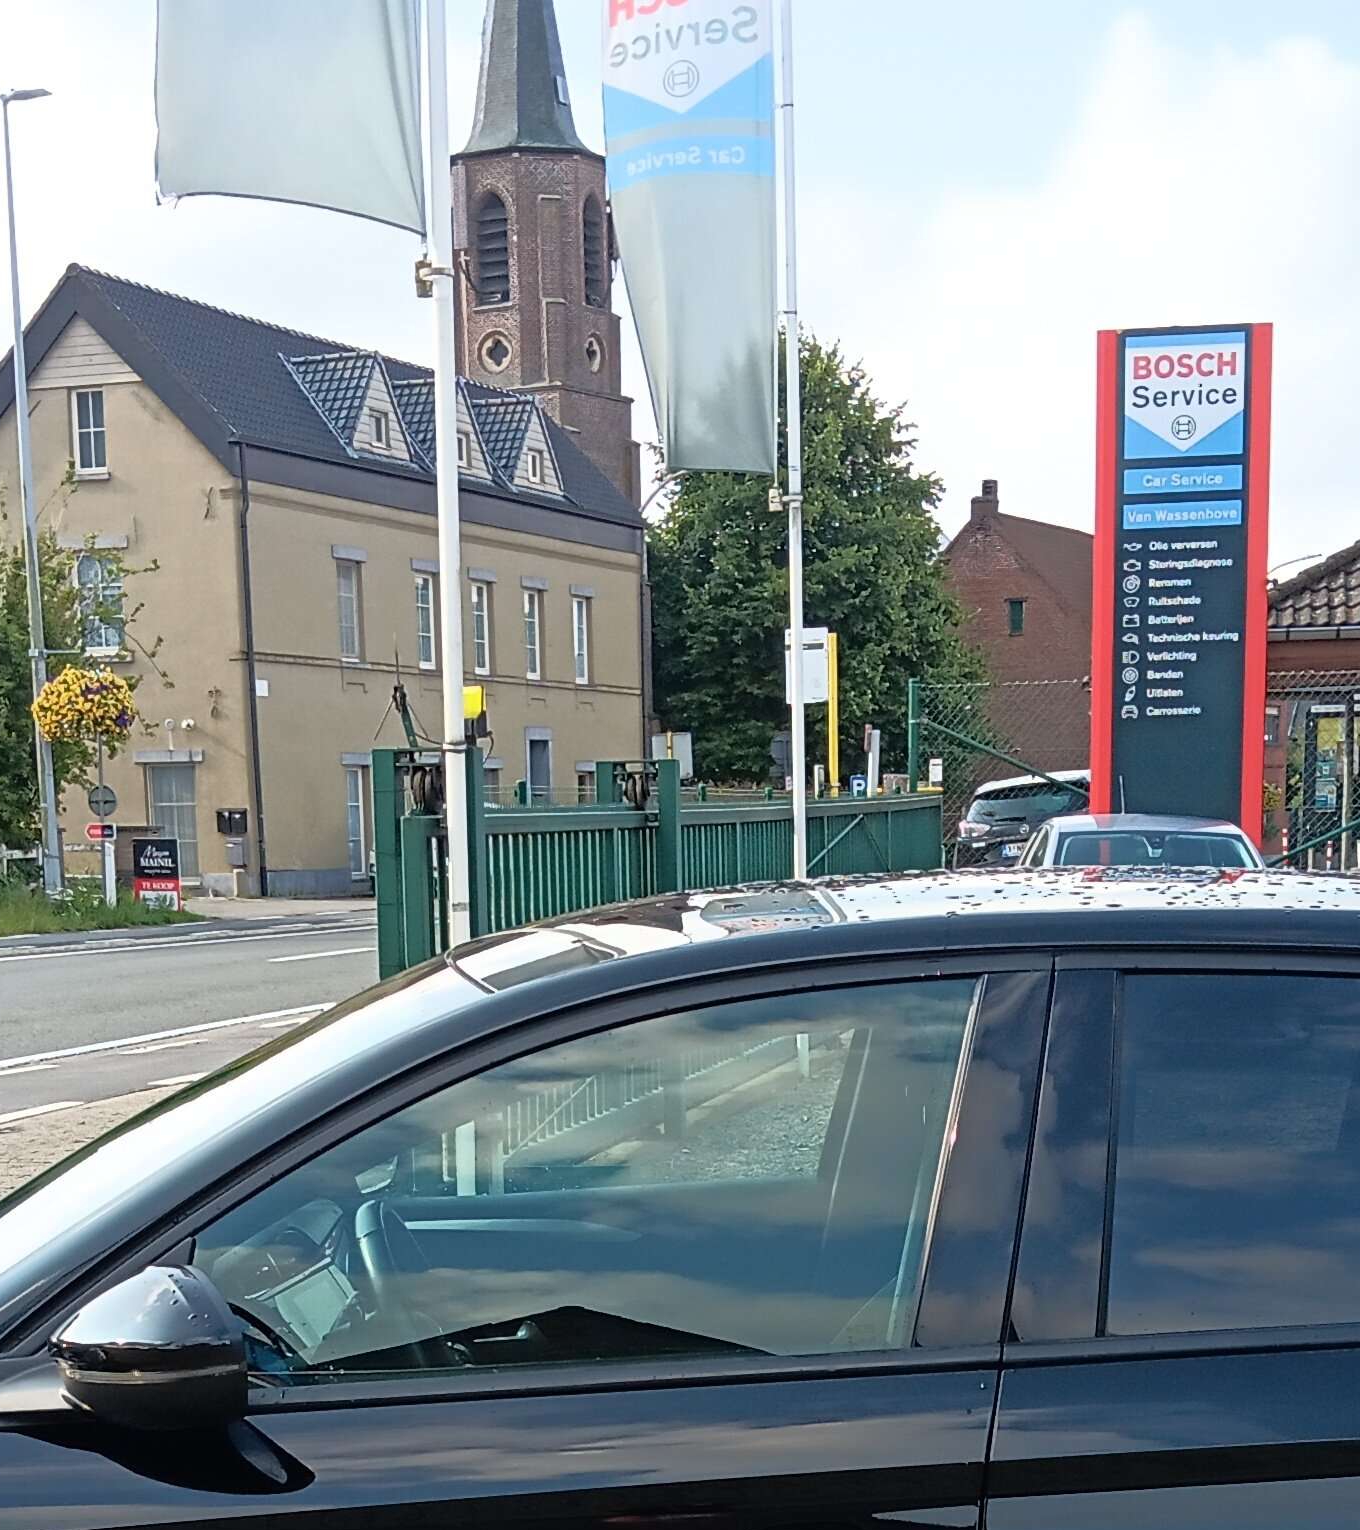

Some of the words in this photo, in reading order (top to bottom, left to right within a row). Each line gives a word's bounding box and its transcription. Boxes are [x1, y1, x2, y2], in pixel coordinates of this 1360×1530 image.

[1133, 352, 1237, 380] BOSCH
[1132, 384, 1237, 408] Service
[1143, 475, 1167, 487] Car
[1171, 472, 1223, 486] Service
[1128, 512, 1152, 523] Van
[1146, 669, 1183, 679] Banden
